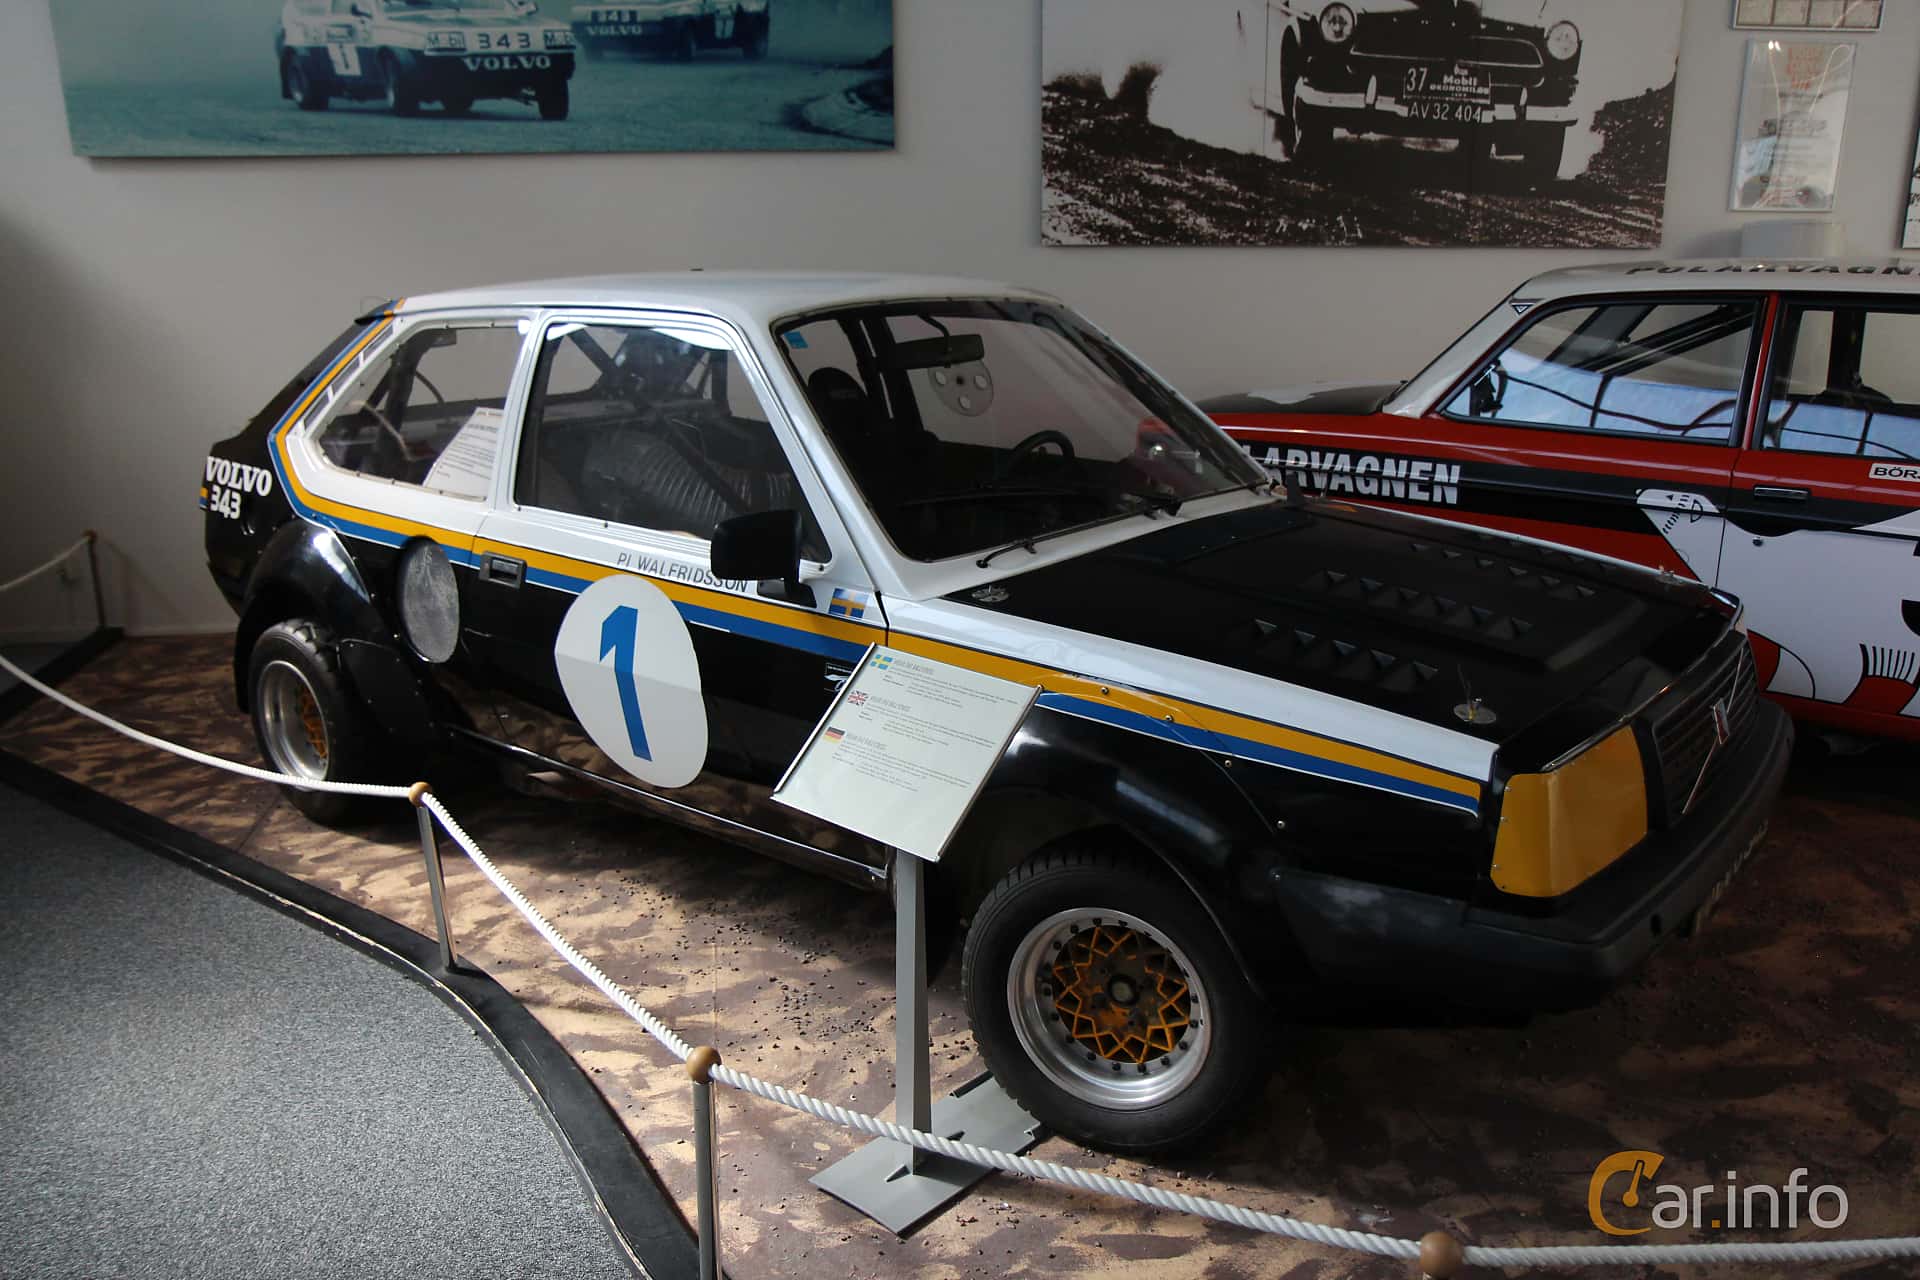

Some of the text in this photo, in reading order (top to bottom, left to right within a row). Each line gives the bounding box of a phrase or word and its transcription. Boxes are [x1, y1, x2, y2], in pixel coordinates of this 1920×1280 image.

[477, 33, 531, 49] 343
[586, 25, 642, 36] VOLVO
[463, 55, 551, 71] VOLVO
[1406, 67, 1428, 92] 37
[1443, 75, 1478, 87] Mobil
[1409, 101, 1481, 123] AV 32 404
[1626, 264, 1920, 275] POLARVAGN
[206, 455, 273, 497] VOLVO
[1242, 444, 1461, 505] ARVAGNEN
[1874, 466, 1920, 479] BÖR
[210, 484, 242, 519] 343
[616, 552, 748, 592] PI WALFRIDSSON
[599, 605, 653, 762] 1
